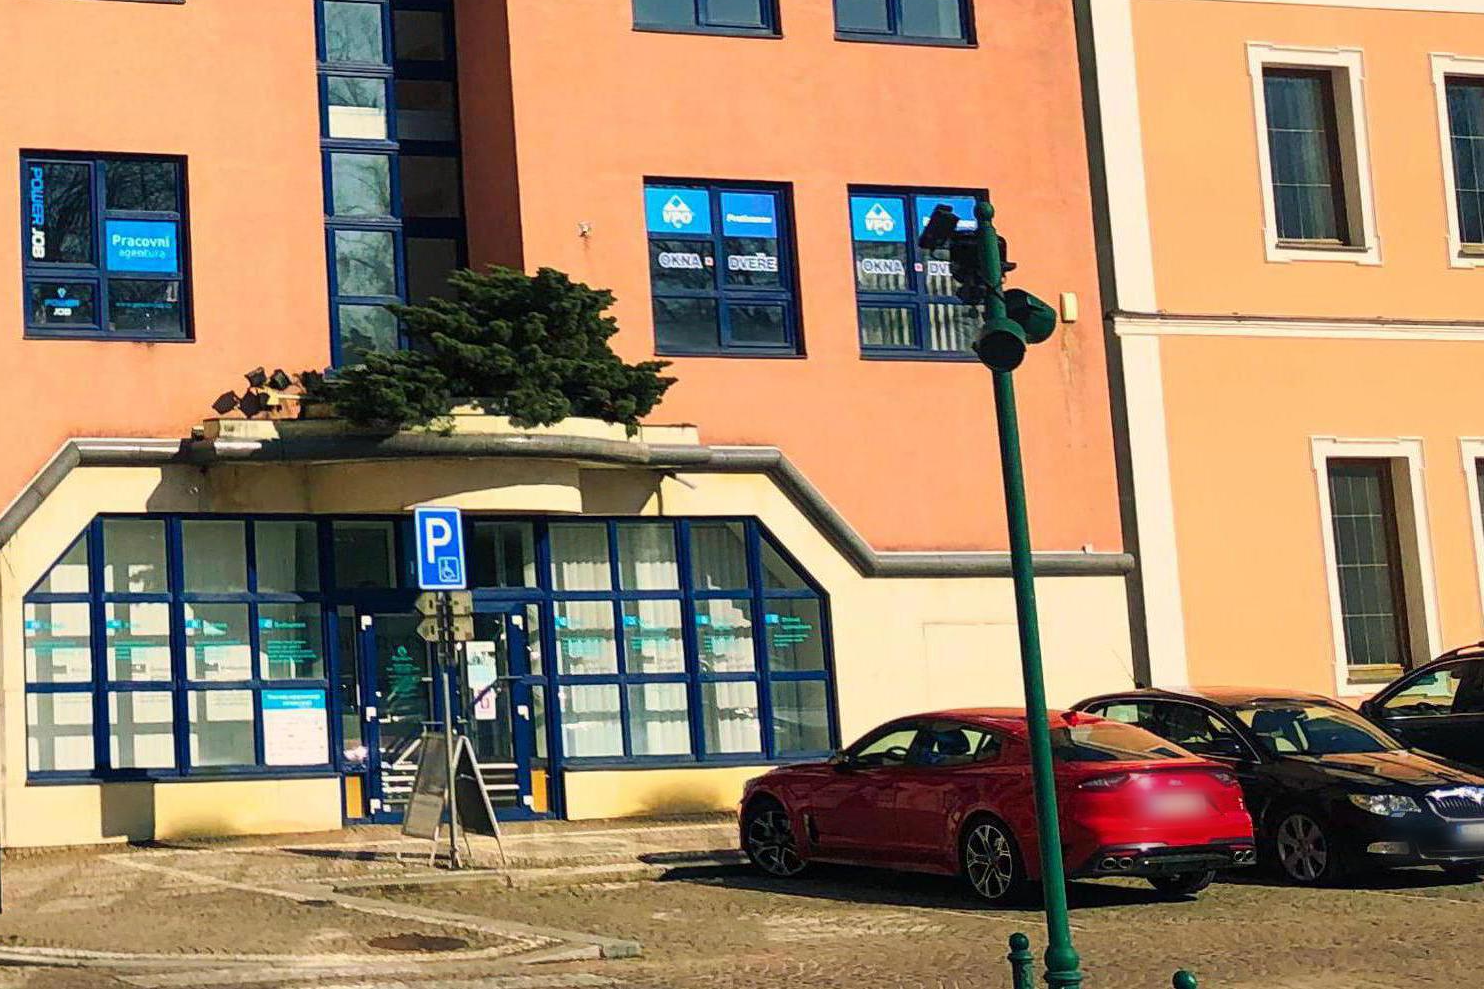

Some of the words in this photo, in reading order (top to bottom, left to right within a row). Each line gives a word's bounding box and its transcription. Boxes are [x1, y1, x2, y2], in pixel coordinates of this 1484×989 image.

[30, 167, 45, 225] POWER
[31, 227, 46, 259] JOB
[118, 248, 166, 259] agentura
[659, 252, 703, 269] OKNA
[728, 253, 778, 272] DVEŘE
[862, 259, 905, 275] OKNA
[425, 517, 453, 564] P
